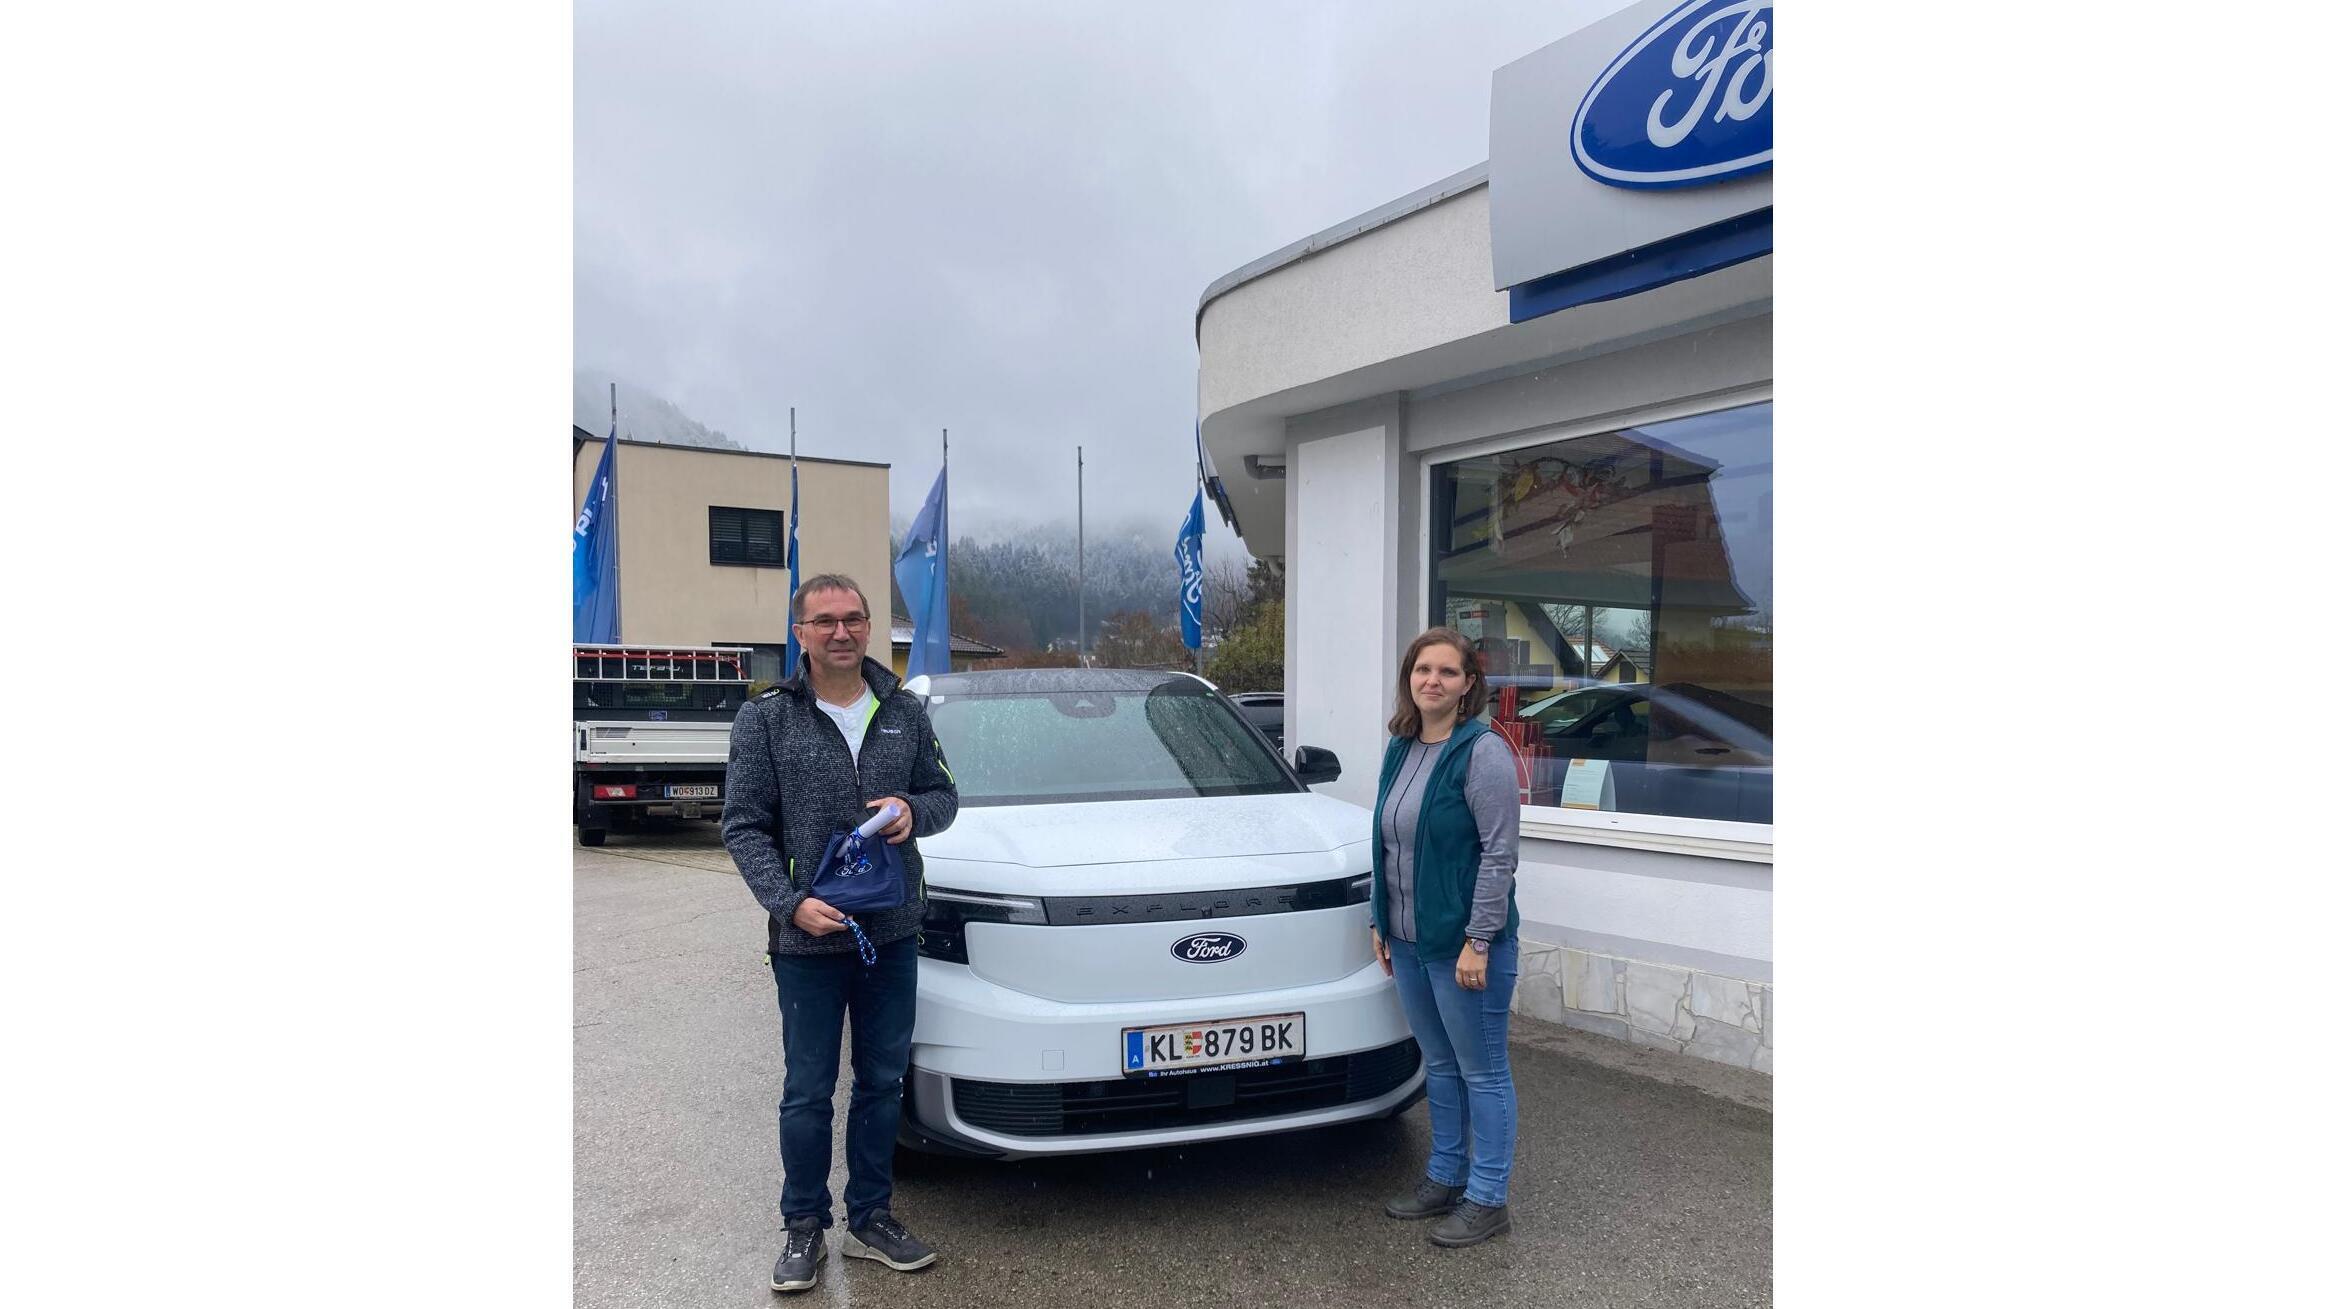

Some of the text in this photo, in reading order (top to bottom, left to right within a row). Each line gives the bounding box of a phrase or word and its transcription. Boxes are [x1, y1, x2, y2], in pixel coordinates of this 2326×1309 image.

[1646, 0, 1773, 148] Fo
[1076, 887, 1322, 918] EXPLORE
[1186, 936, 1233, 959] Ford
[1131, 1022, 1293, 1064] A KL 879 BK
[1168, 1067, 1197, 1076] Autohaus
